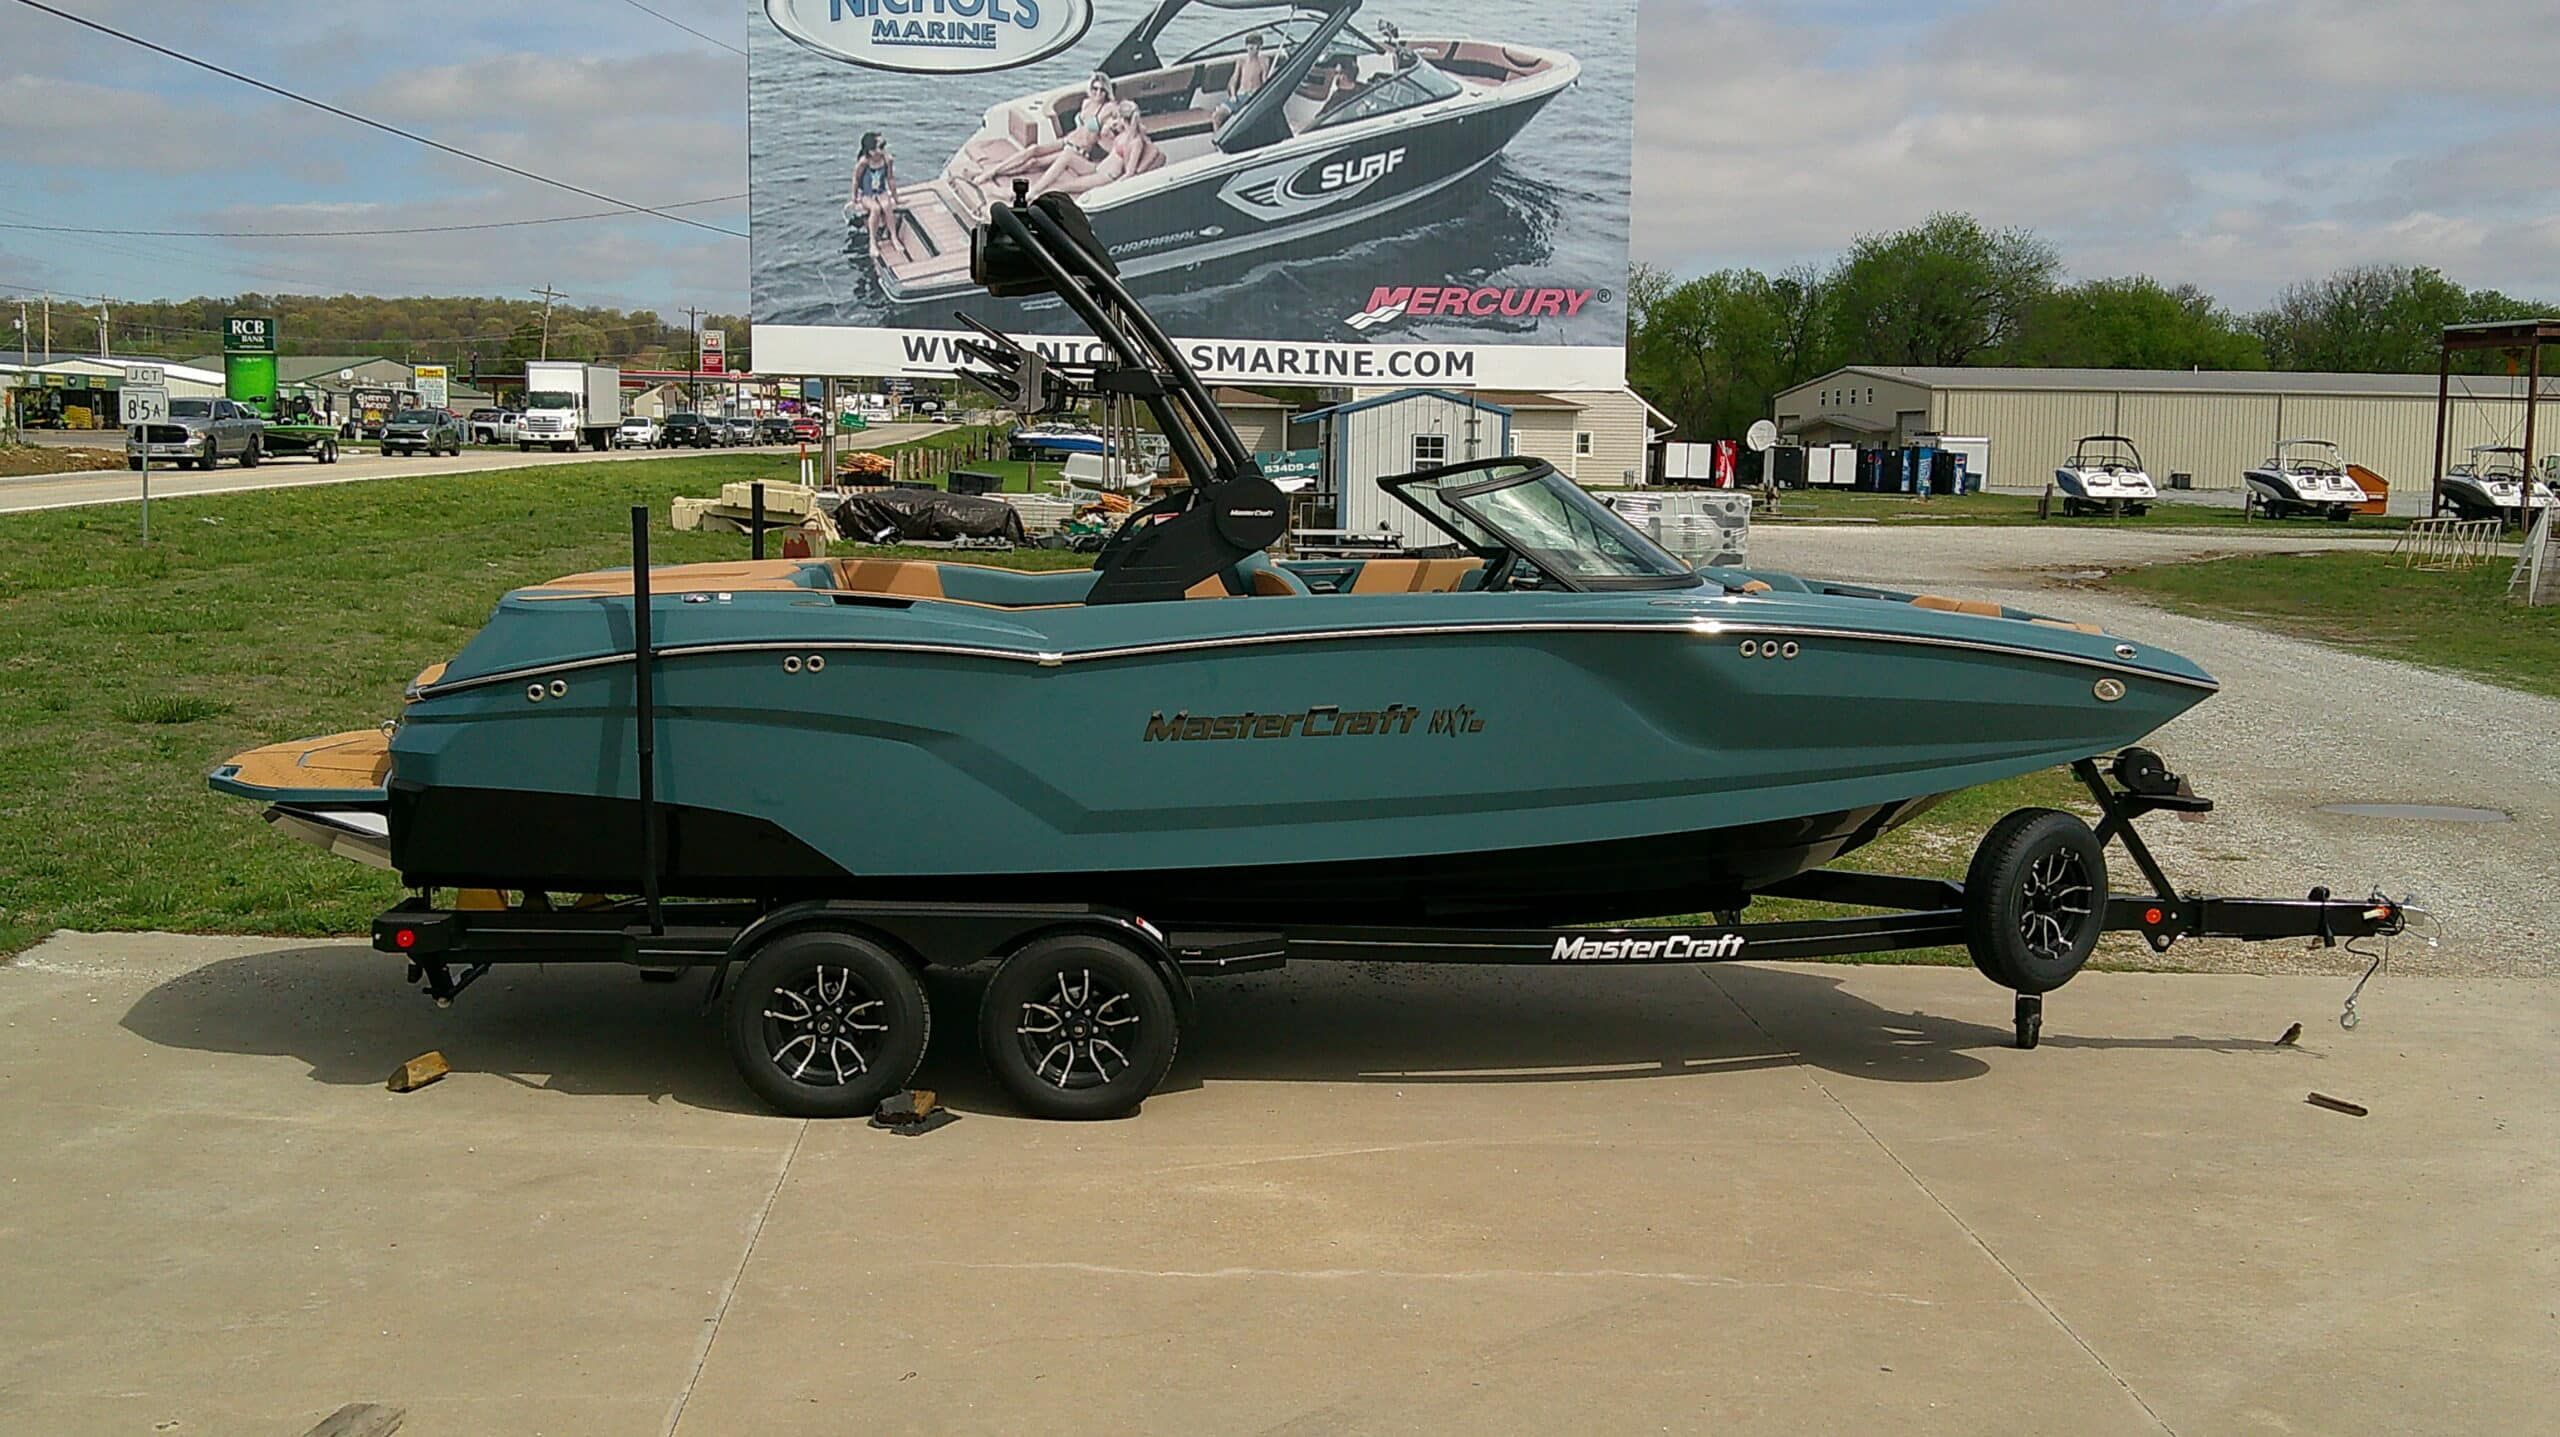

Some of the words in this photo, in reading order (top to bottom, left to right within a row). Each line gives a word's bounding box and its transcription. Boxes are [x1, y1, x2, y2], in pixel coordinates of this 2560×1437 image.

[872, 19, 996, 41] MARINE
[1321, 147, 1406, 190] SURF
[1365, 287, 1592, 316] MERCURY
[231, 319, 265, 335] RCB
[131, 369, 159, 381] JCT
[128, 399, 161, 420] 85A
[1144, 704, 1420, 742] MasterCraft
[1551, 933, 1745, 960] MasterCraft
